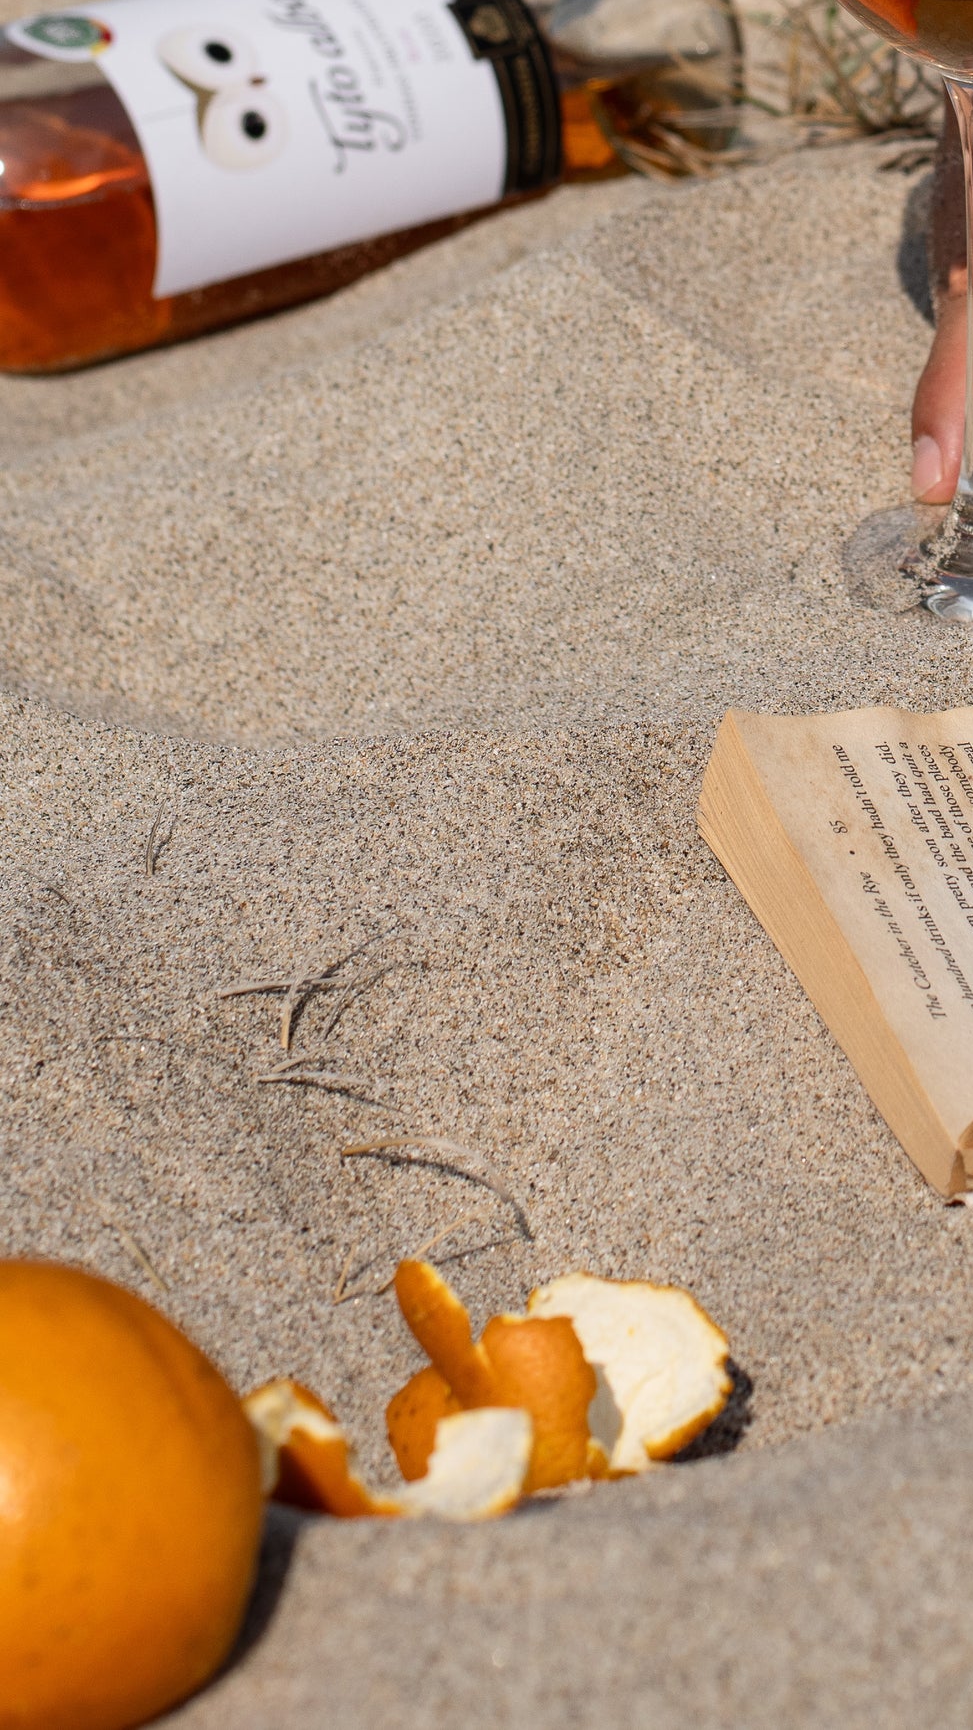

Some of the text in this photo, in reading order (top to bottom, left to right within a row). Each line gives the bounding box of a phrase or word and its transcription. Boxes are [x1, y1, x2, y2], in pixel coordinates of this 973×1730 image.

[831, 744, 851, 763] me
[874, 740, 897, 765] did.
[901, 751, 926, 779] quit
[917, 744, 951, 783] places
[838, 764, 864, 789] told
[891, 770, 913, 798] they
[913, 781, 938, 806] had
[939, 784, 965, 819] those
[906, 802, 930, 834] after
[926, 809, 955, 839] band
[952, 819, 973, 835] of
[877, 832, 901, 860] they
[924, 838, 949, 868] soon
[949, 842, 967, 863] the
[893, 861, 916, 891] only
[904, 892, 924, 903] if
[828, 820, 947, 1019] The Catcher in the Rye 85
[916, 905, 946, 946] drinks
